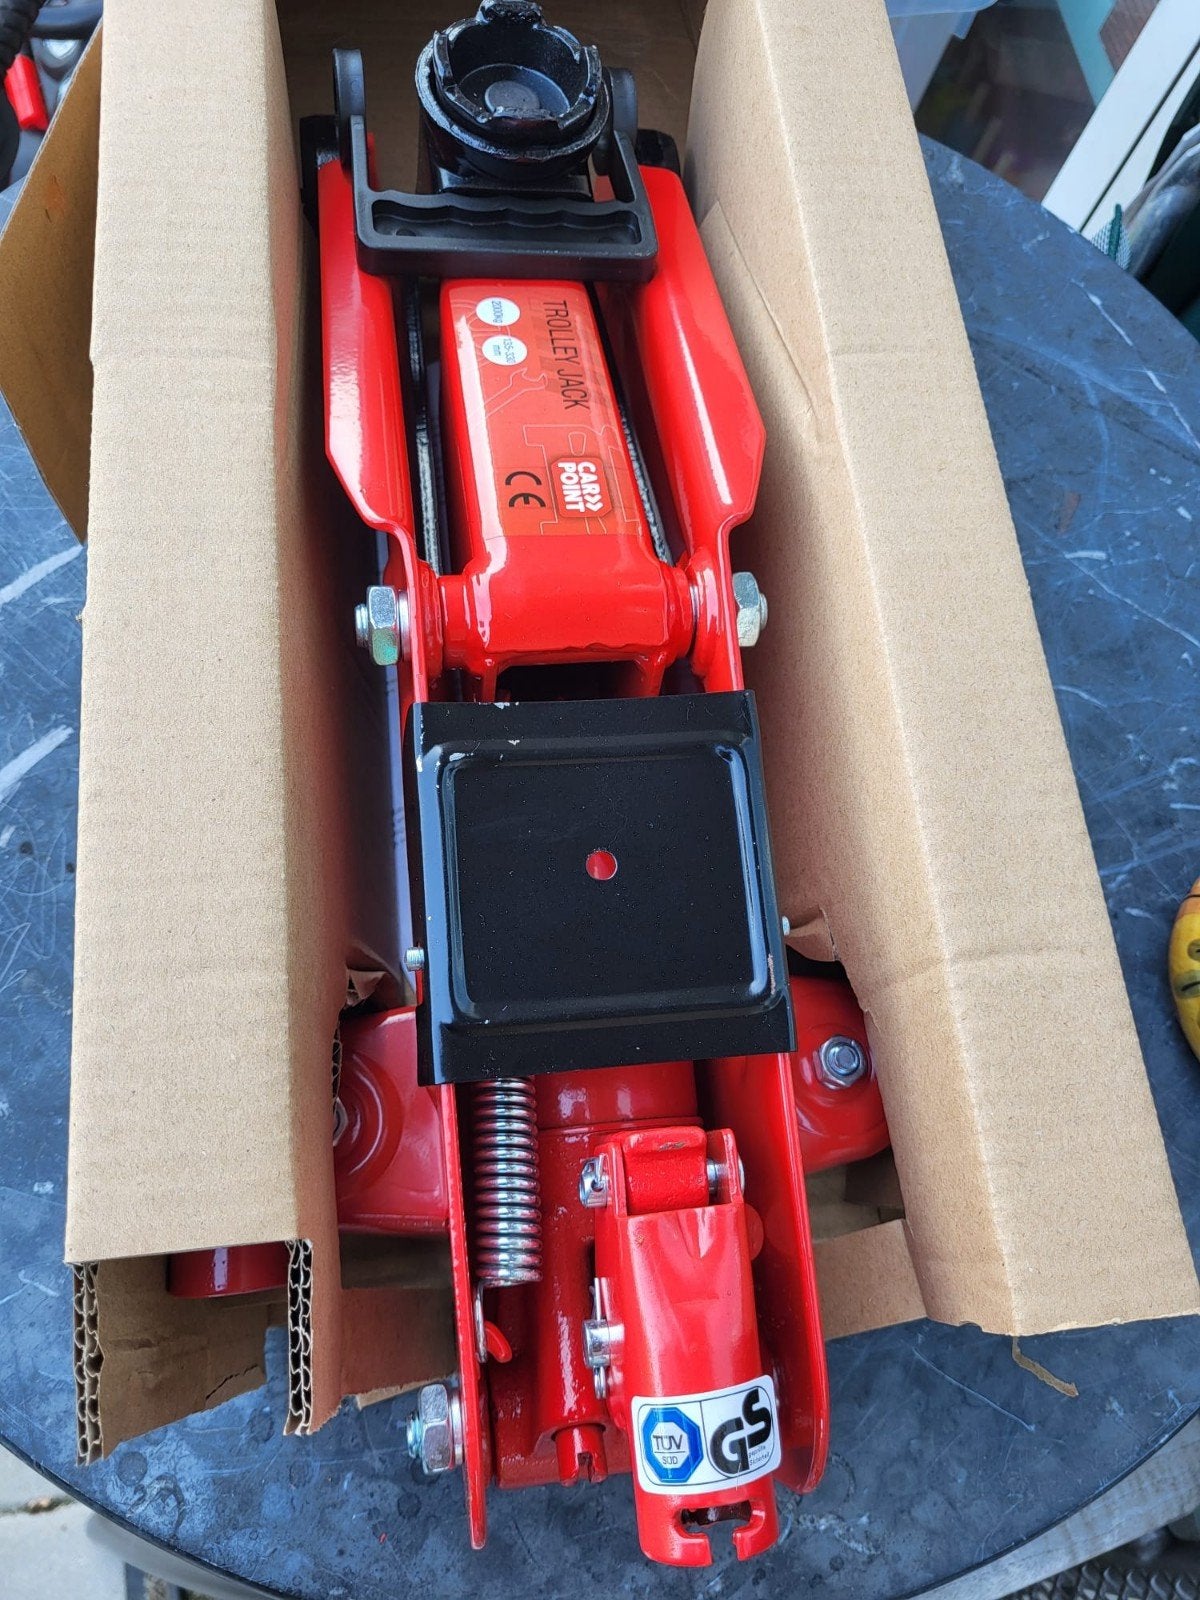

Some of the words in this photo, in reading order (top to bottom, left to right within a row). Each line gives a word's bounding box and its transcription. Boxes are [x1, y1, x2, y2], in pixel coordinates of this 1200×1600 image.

[491, 300, 504, 324] 2000kg
[543, 300, 580, 367] TROLLEY
[556, 368, 592, 410] JACK
[505, 470, 546, 508] CE
[557, 461, 587, 513] POINT
[652, 1434, 683, 1451] TÜV
[710, 1388, 772, 1475] GS
